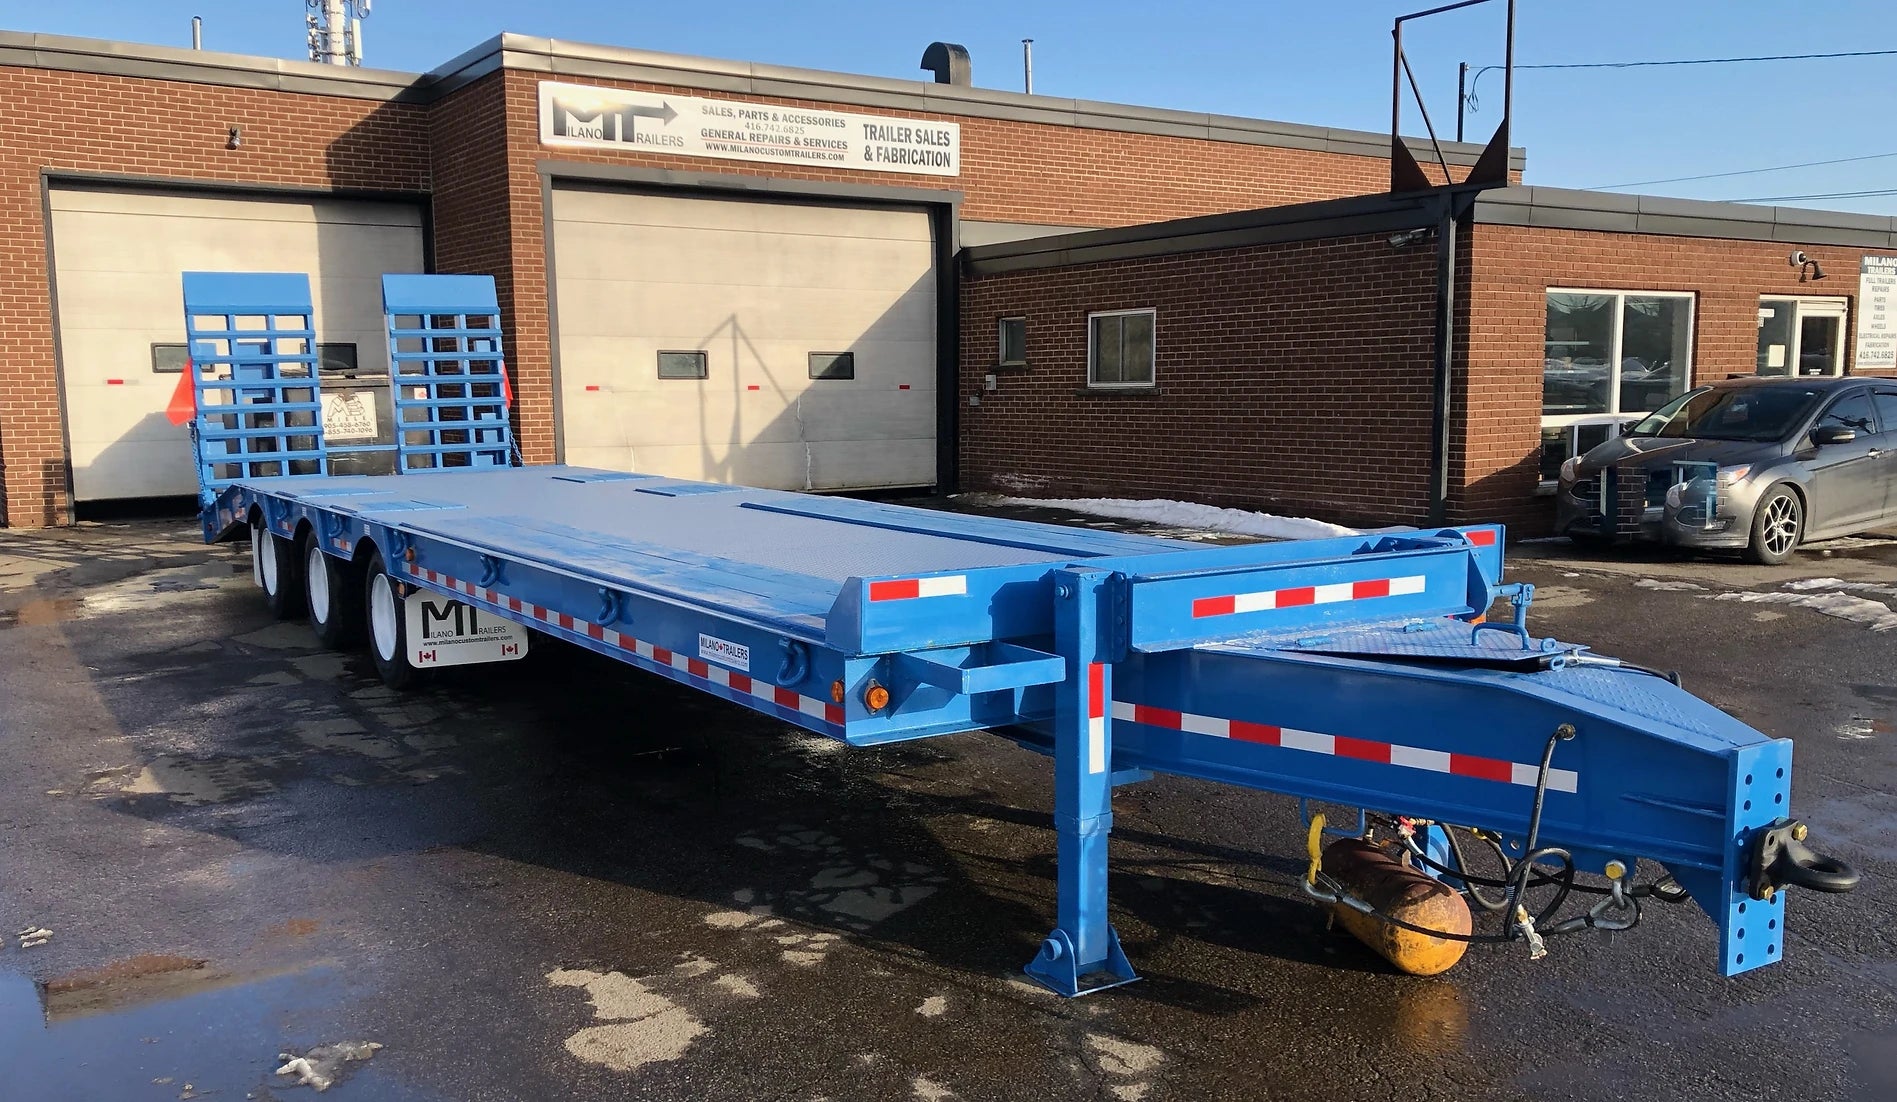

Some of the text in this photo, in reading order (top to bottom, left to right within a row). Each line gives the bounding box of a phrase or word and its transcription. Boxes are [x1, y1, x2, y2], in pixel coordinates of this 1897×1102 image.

[702, 105, 846, 128] SALES, PARTS & ACCESSORIES
[744, 122, 805, 135] 416.742.6825
[863, 123, 950, 147] TRAILER SALES
[701, 128, 848, 150] GENERAL REPAIRS & SERVICES
[705, 142, 845, 161] WWW.MILANOCUSTOMTRAILERS.COM
[864, 145, 951, 168] & FABRICATION
[1864, 256, 1897, 267] MILANO
[1867, 266, 1896, 275] TRAILERS
[1859, 350, 1894, 359] 416.742.6825
[421, 599, 465, 639] MILANO
[423, 634, 513, 647] www.milanocustomtrailers.com
[701, 636, 748, 660] MILANO TRAILERS
